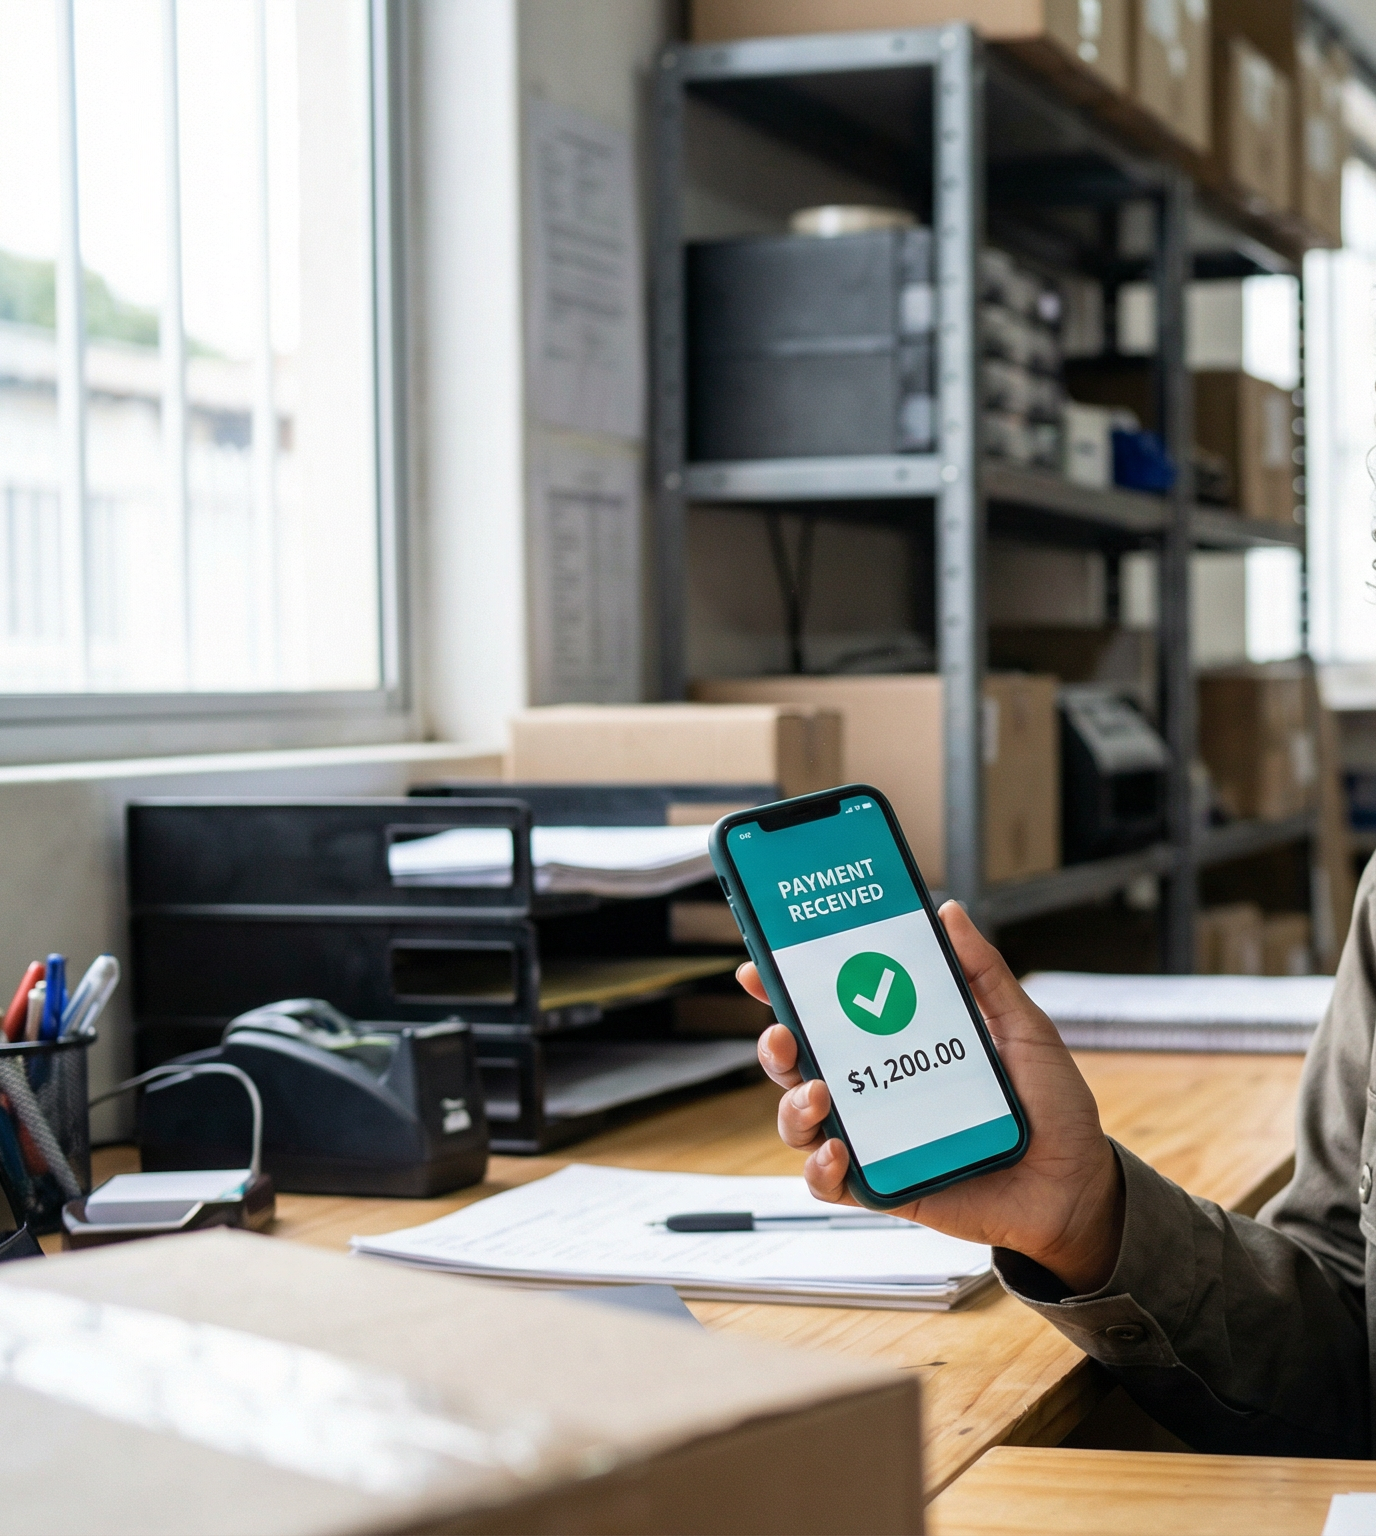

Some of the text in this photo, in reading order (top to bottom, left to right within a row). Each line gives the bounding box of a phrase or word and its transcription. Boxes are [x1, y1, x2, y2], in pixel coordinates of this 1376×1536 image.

[777, 858, 874, 900] PAYMENT
[788, 883, 884, 923] RECEIVED
[847, 1037, 966, 1095] $1,200.00
